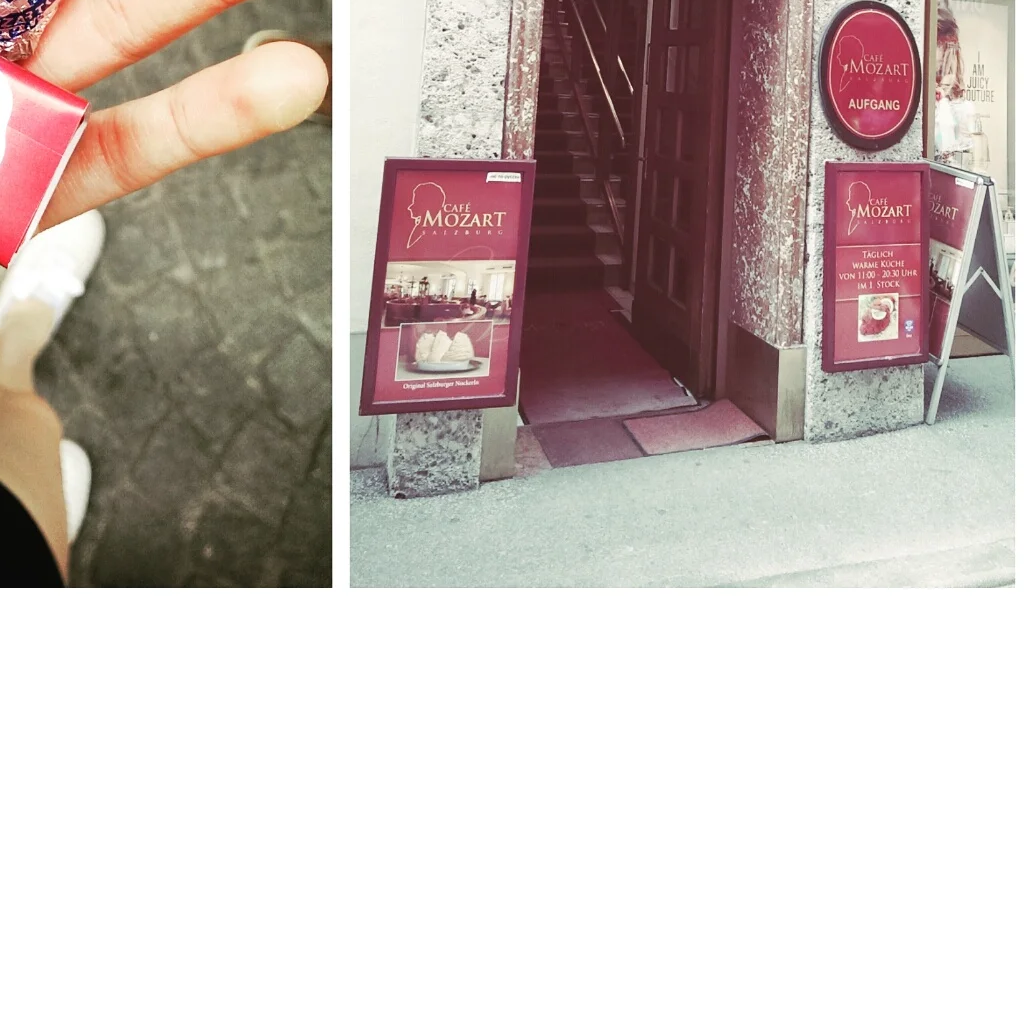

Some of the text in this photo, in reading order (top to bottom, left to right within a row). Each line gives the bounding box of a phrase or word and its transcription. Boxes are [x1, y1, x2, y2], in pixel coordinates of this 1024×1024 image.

[863, 53, 884, 62] CAFÉ
[849, 58, 910, 77] MOZART
[972, 64, 985, 75] AM
[966, 76, 990, 89] JUICY
[848, 98, 901, 111] AUFGANG
[443, 202, 471, 213] CAFÉ
[869, 197, 888, 206] CAFÉ
[856, 203, 912, 218] MOZART
[928, 200, 959, 221] OZART
[422, 209, 507, 227] MOZART
[852, 261, 879, 269] WARME
[839, 272, 856, 280] VON
[901, 268, 918, 277] UHR
[857, 281, 867, 289] IM
[876, 280, 901, 289] STOCK
